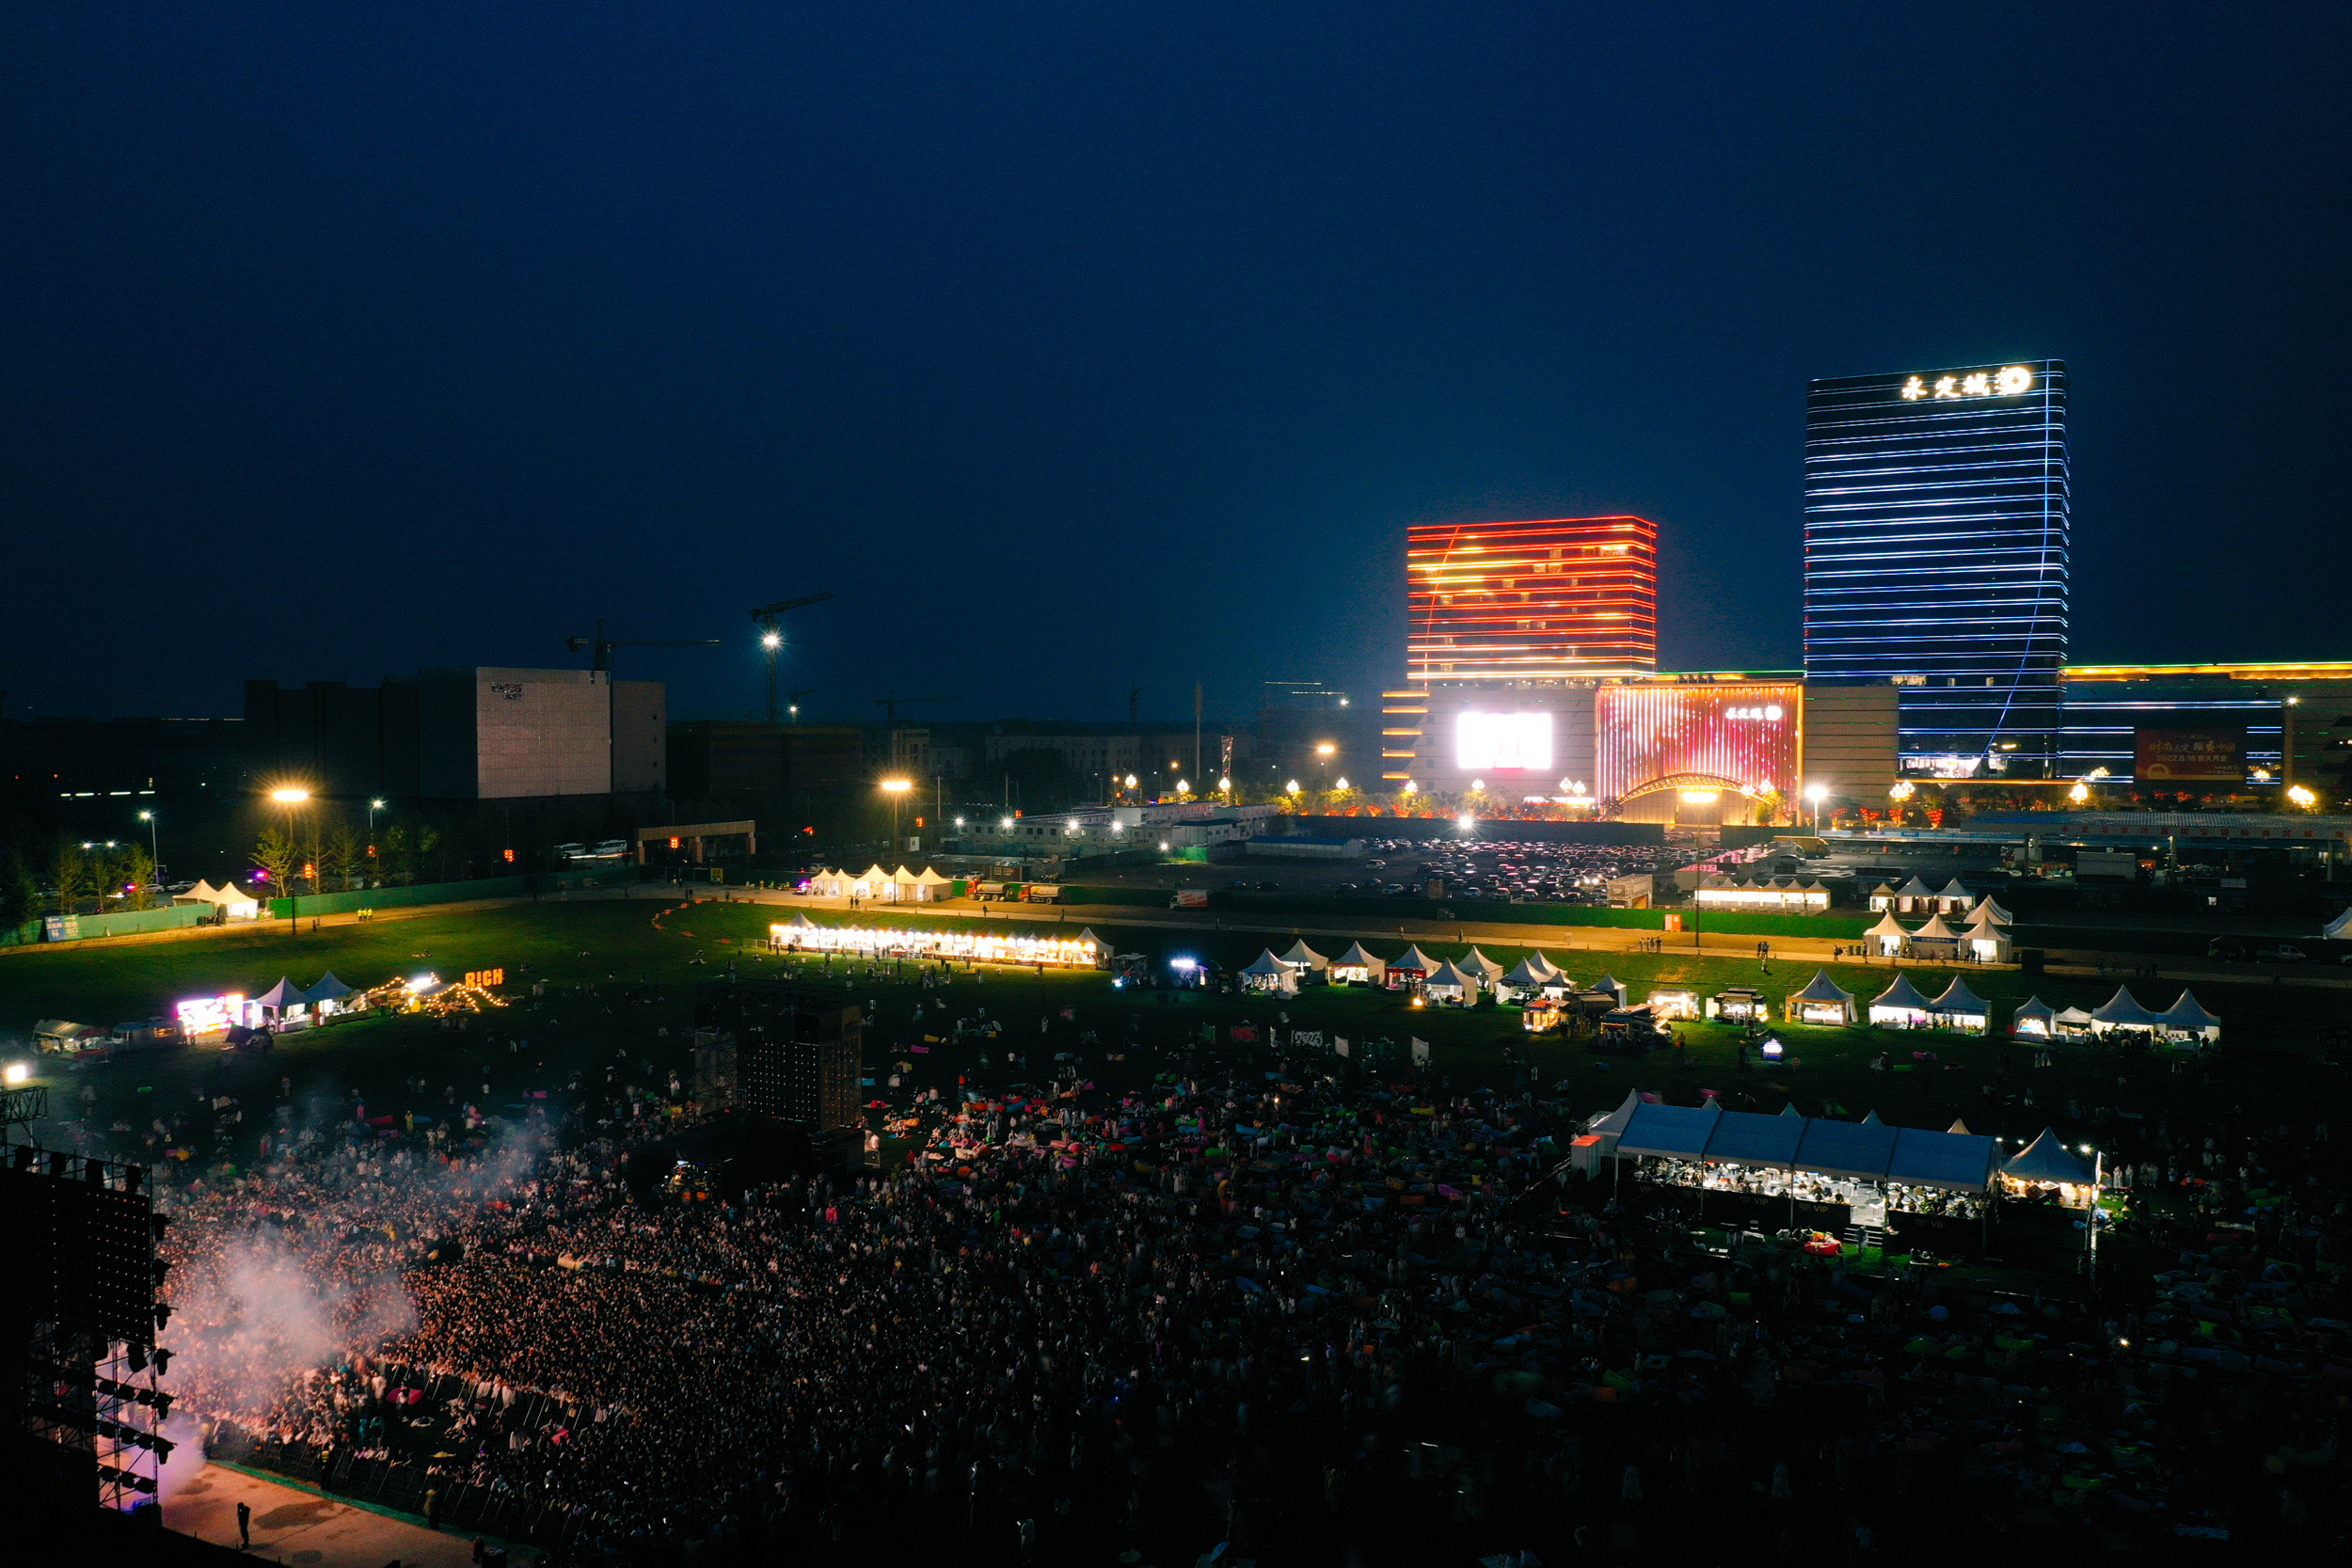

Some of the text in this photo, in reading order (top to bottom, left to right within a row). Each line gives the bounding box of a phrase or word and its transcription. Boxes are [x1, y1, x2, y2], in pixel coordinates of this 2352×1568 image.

[1695, 1191, 1710, 1199] VP
[1754, 1197, 1769, 1206] VIP
[1813, 1205, 1829, 1213] VIP
